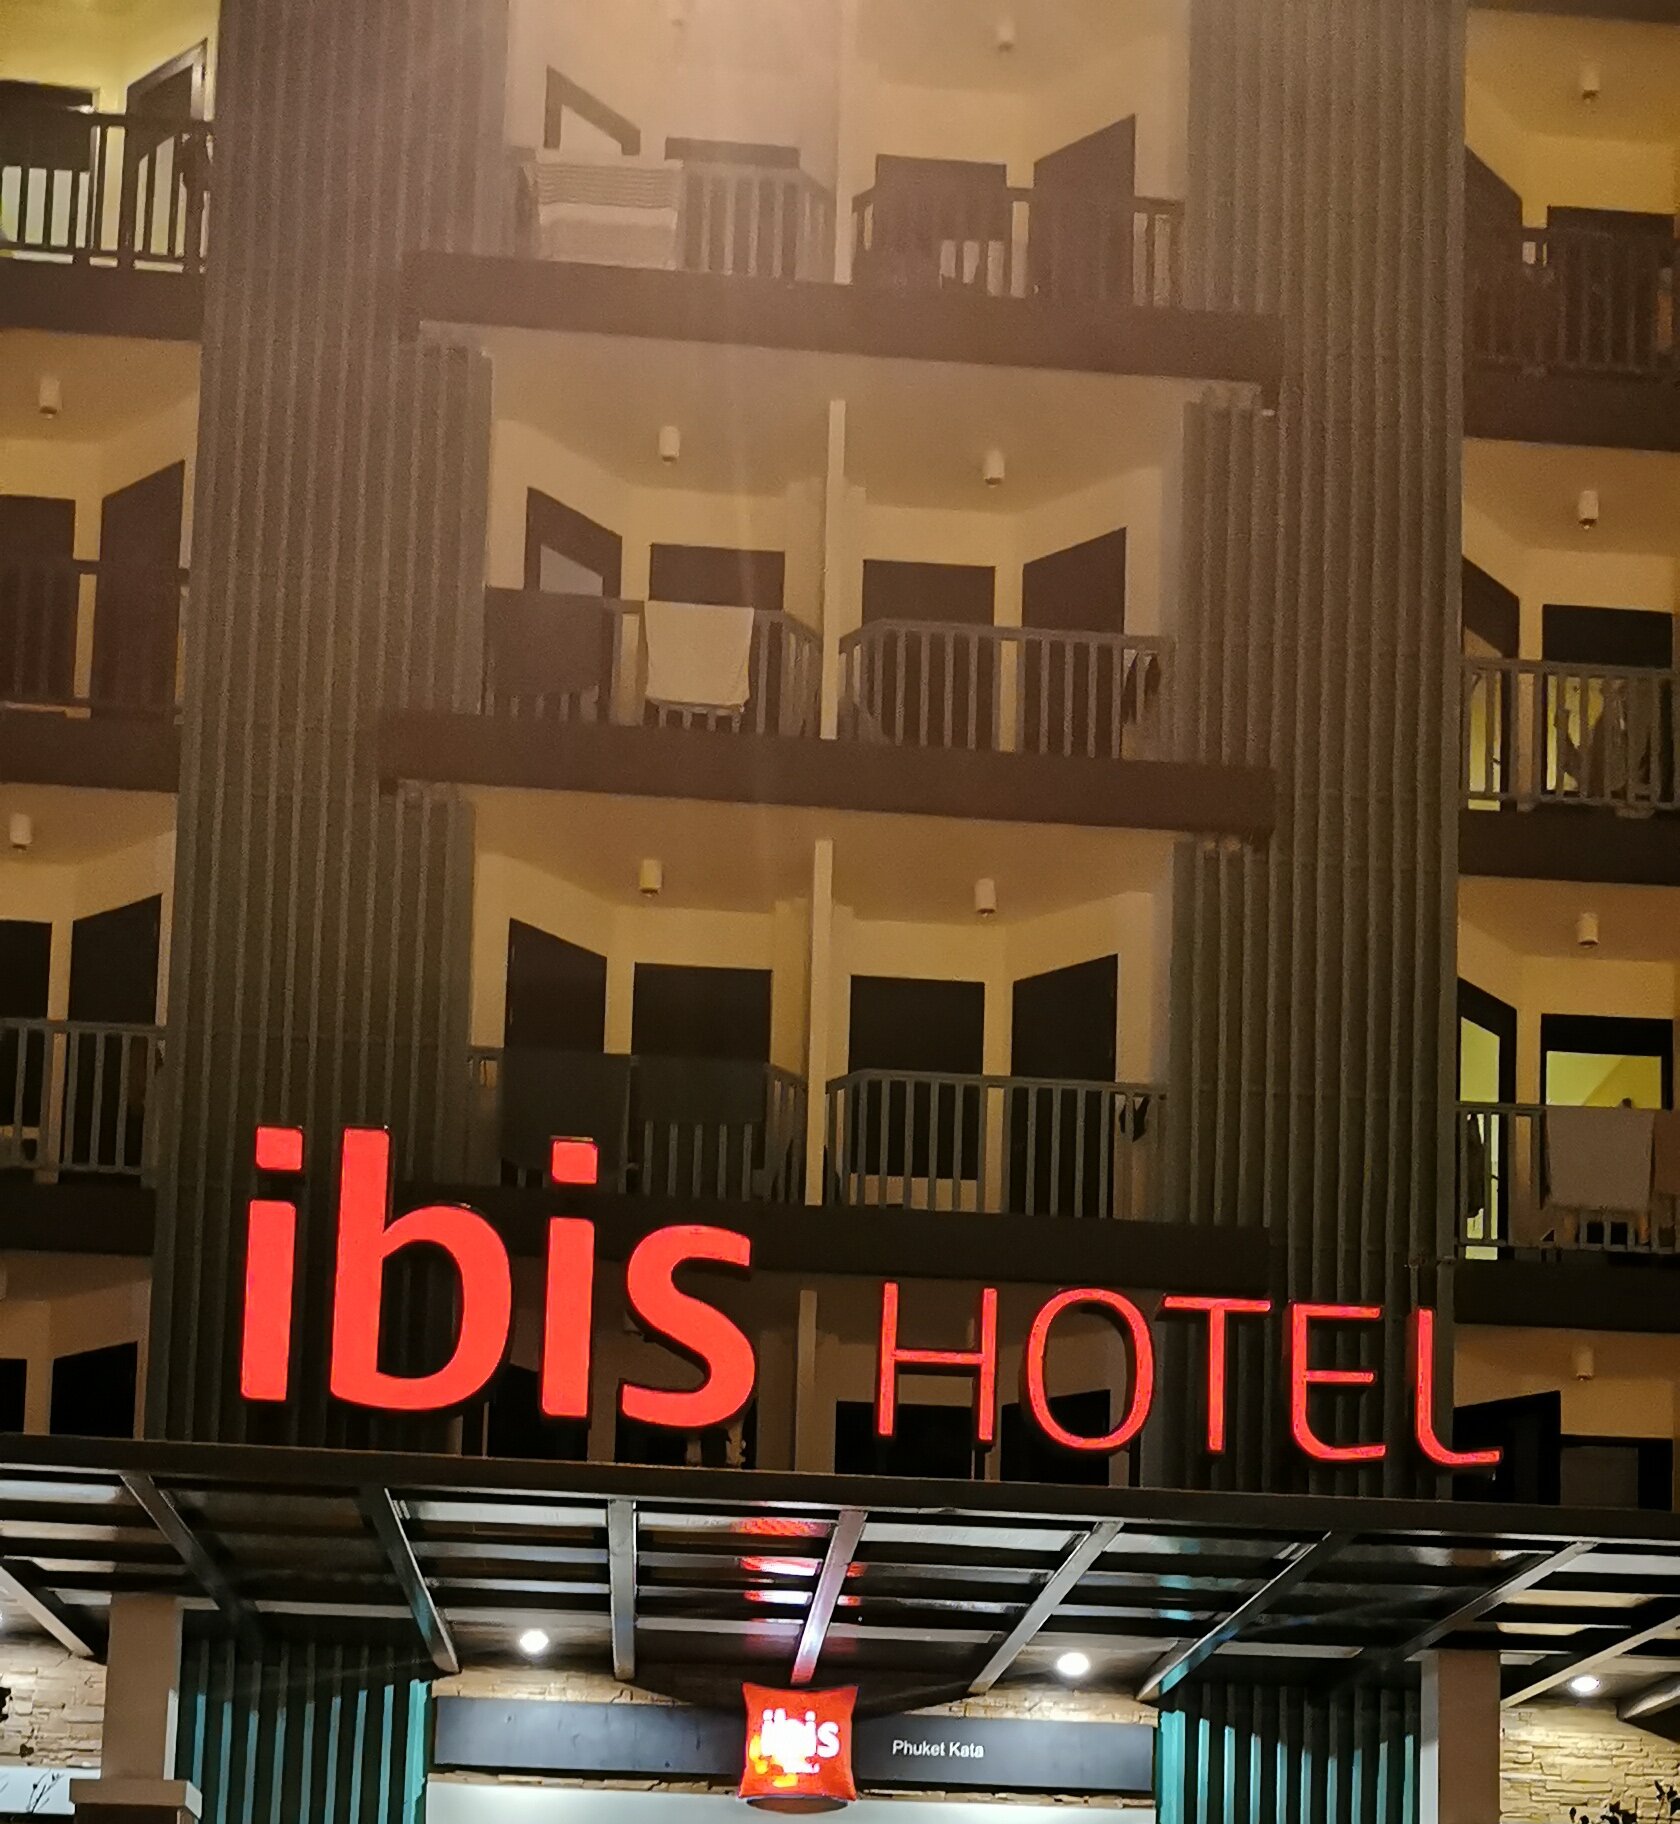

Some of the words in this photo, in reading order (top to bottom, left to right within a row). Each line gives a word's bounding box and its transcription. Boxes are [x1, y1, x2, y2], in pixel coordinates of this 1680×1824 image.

[240, 1126, 757, 1429] ibis
[877, 1282, 1502, 1466] HOTEL
[760, 1707, 840, 1758] ibis
[892, 1739, 945, 1757] Phuket
[949, 1741, 984, 1759] Kata
